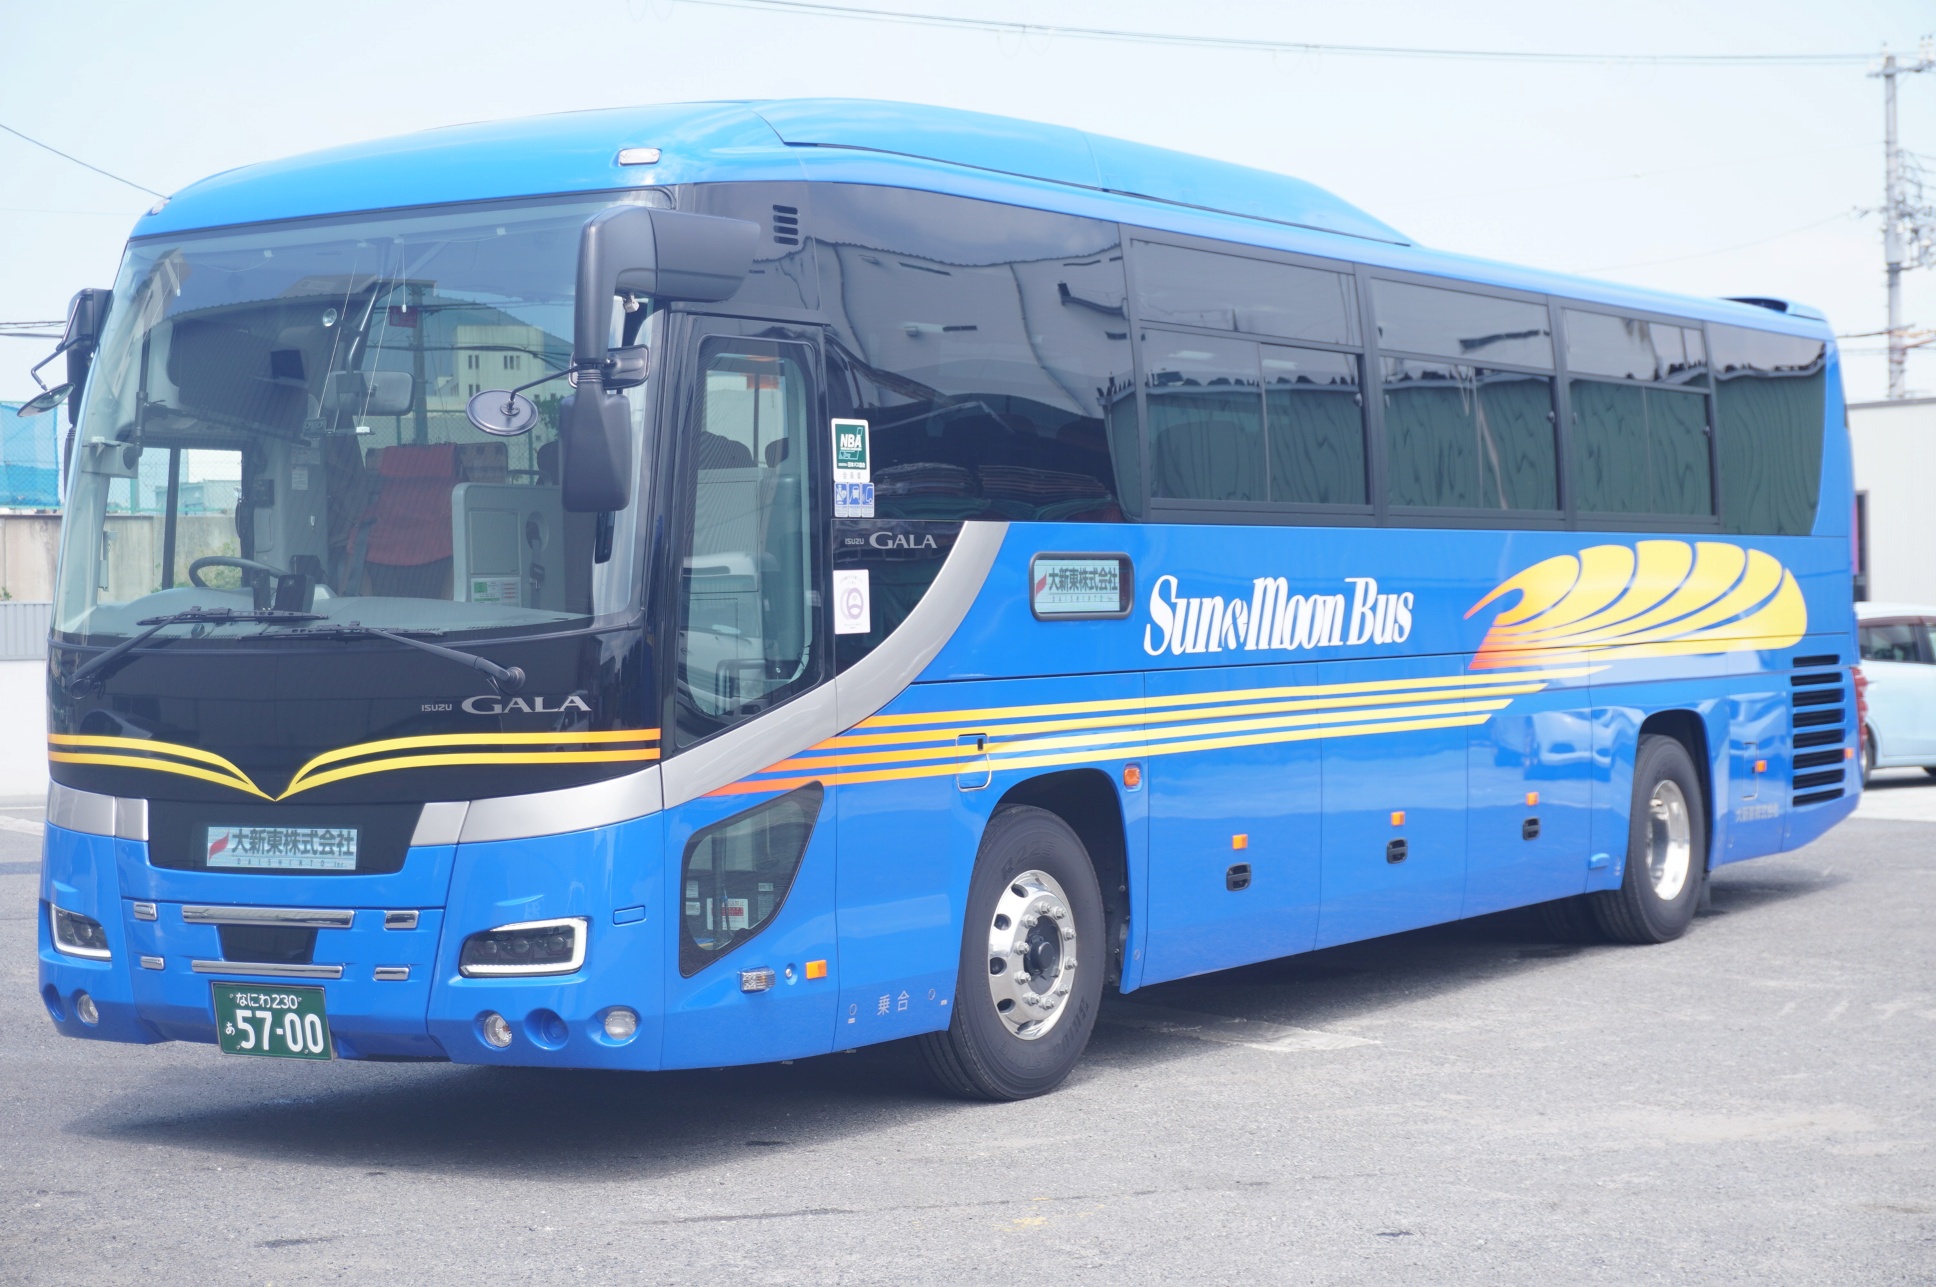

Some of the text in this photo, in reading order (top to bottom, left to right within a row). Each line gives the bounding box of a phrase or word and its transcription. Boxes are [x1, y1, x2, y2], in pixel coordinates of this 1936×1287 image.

[840, 433, 862, 448] NBA
[844, 531, 938, 549] ISUZU GALA
[1048, 567, 1118, 592] 大新東株式会社
[1344, 577, 1414, 645] Bus
[421, 695, 592, 715] ISUZU GALA
[231, 828, 355, 857] 大新東株式会社
[237, 857, 325, 867] DAISHINTO
[877, 990, 910, 1016] 乗合
[225, 1009, 324, 1054] あ 57-00
